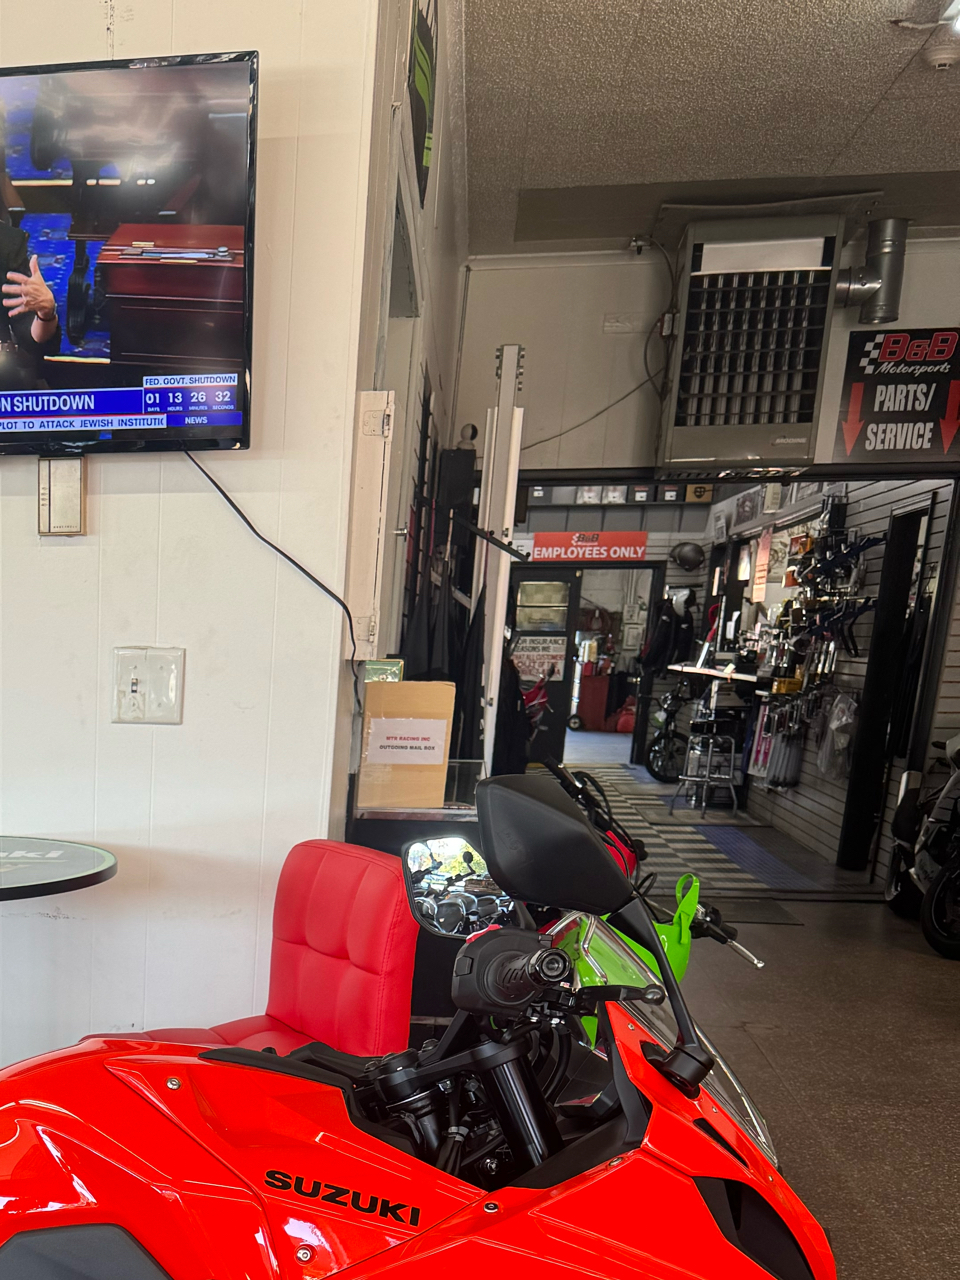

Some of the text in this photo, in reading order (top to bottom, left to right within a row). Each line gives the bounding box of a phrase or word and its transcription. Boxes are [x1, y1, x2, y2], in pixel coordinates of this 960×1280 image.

[878, 332, 959, 362] B&B
[875, 362, 951, 377] Motorsports
[145, 376, 236, 386] FED. GOVT. SHUTDOWN
[14, 395, 95, 413] SHUTDOWN
[146, 391, 231, 404] 01 13 26 32
[874, 383, 936, 412] PARTS/
[22, 421, 35, 430] TO
[39, 420, 75, 429] ATTACK
[79, 418, 113, 428] JEWISH
[185, 416, 208, 424] NEWS
[865, 422, 934, 450] SERVICE
[534, 546, 645, 559] EMPLOYEES ONLY
[264, 1169, 421, 1227] SUZUKI
